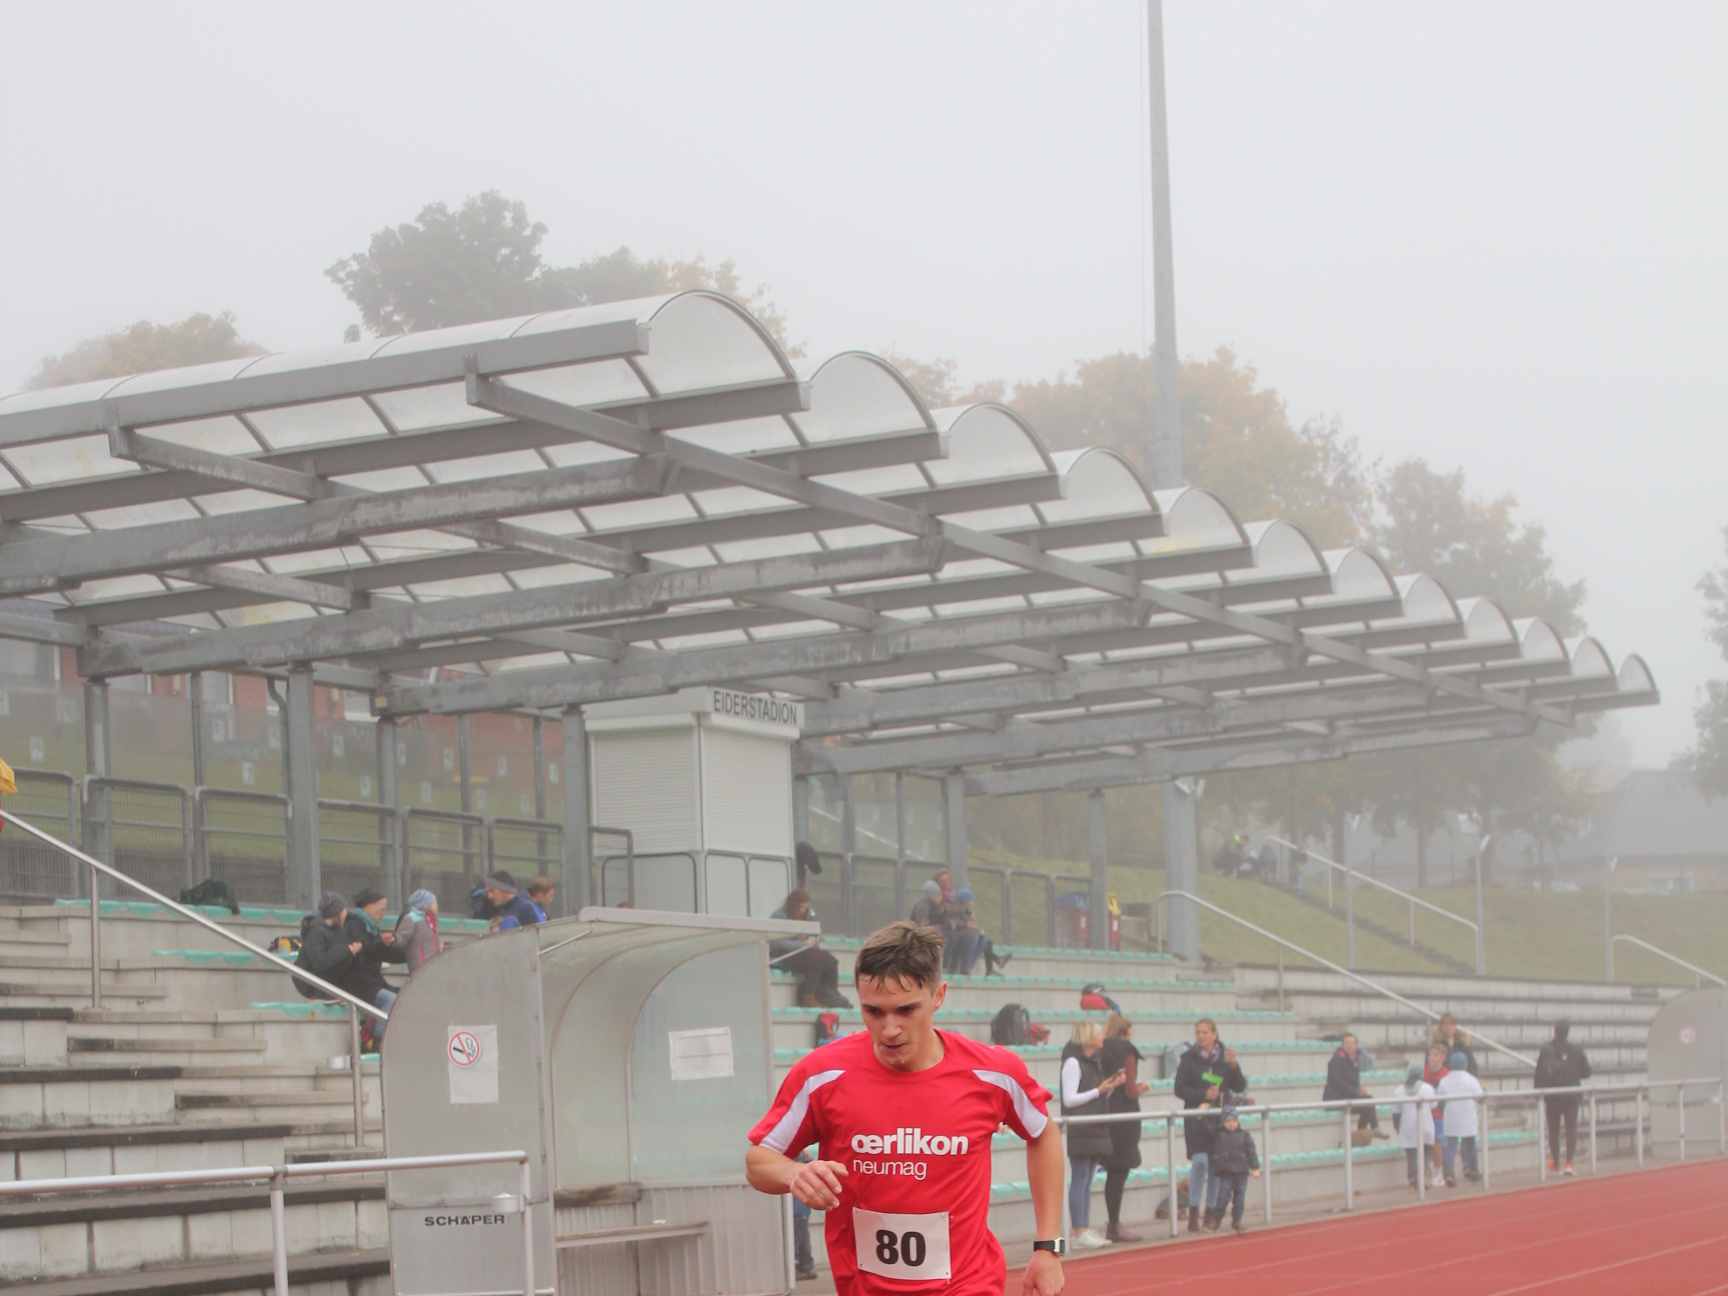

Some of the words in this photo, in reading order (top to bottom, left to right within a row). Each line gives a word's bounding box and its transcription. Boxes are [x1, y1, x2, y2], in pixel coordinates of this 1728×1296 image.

[713, 690, 798, 725] EIDERSTADION
[853, 1160, 927, 1181] neumag
[876, 1229, 926, 1267] 80
